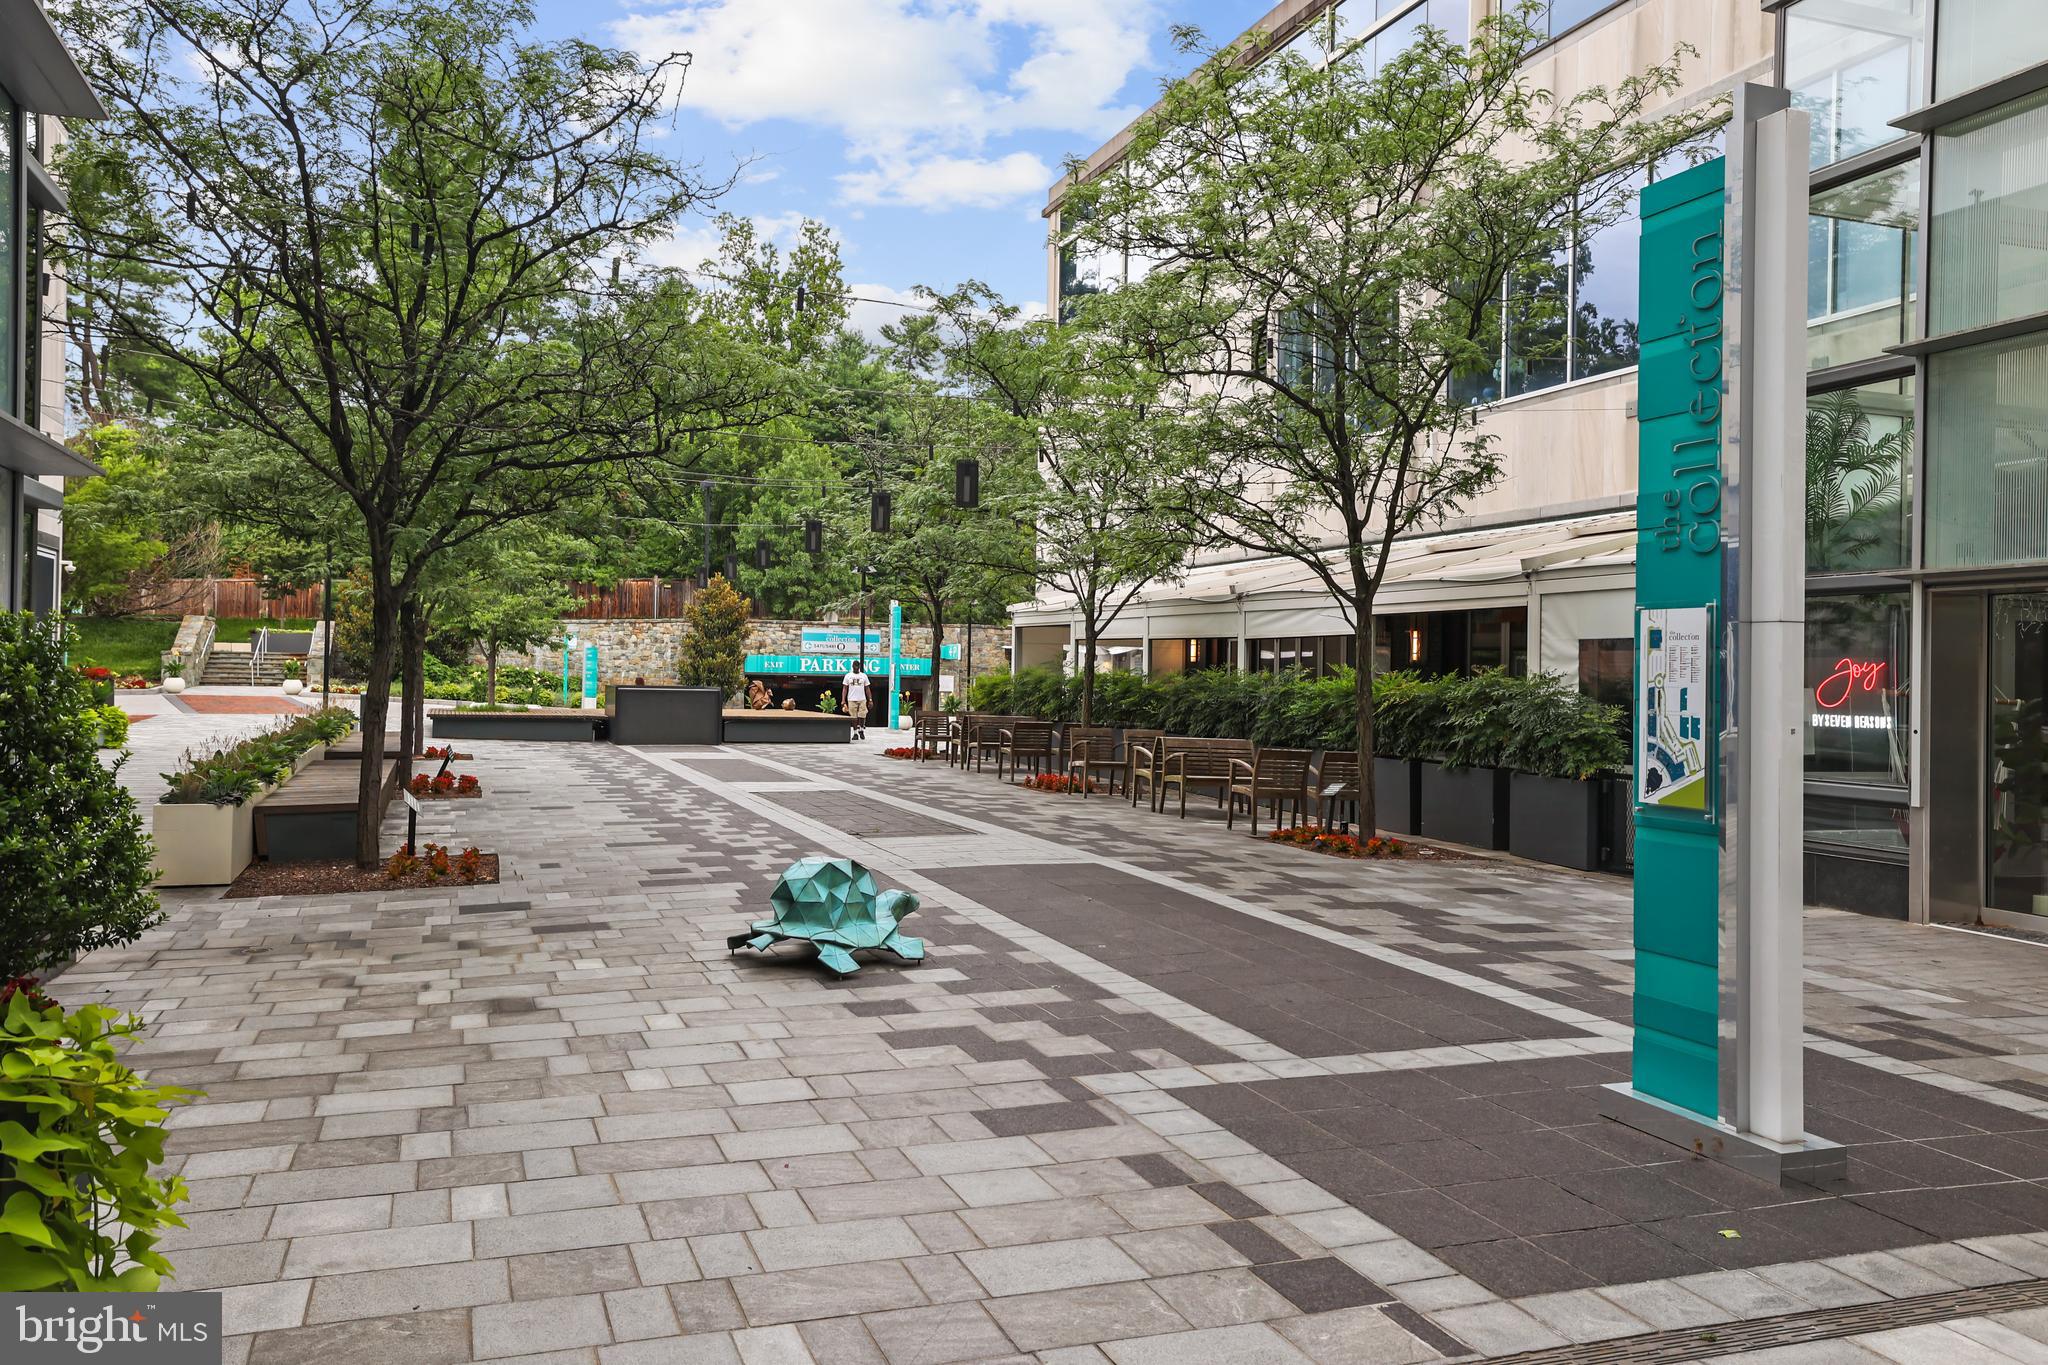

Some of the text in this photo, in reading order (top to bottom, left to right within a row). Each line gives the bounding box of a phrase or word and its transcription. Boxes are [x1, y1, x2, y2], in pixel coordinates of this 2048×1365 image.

[1673, 219, 1724, 554] collection
[1654, 488, 1681, 552] the
[1669, 633, 1700, 641] collection
[1816, 658, 1886, 708] Joy
[1811, 714, 1892, 729] BY SEVEN REASONS
